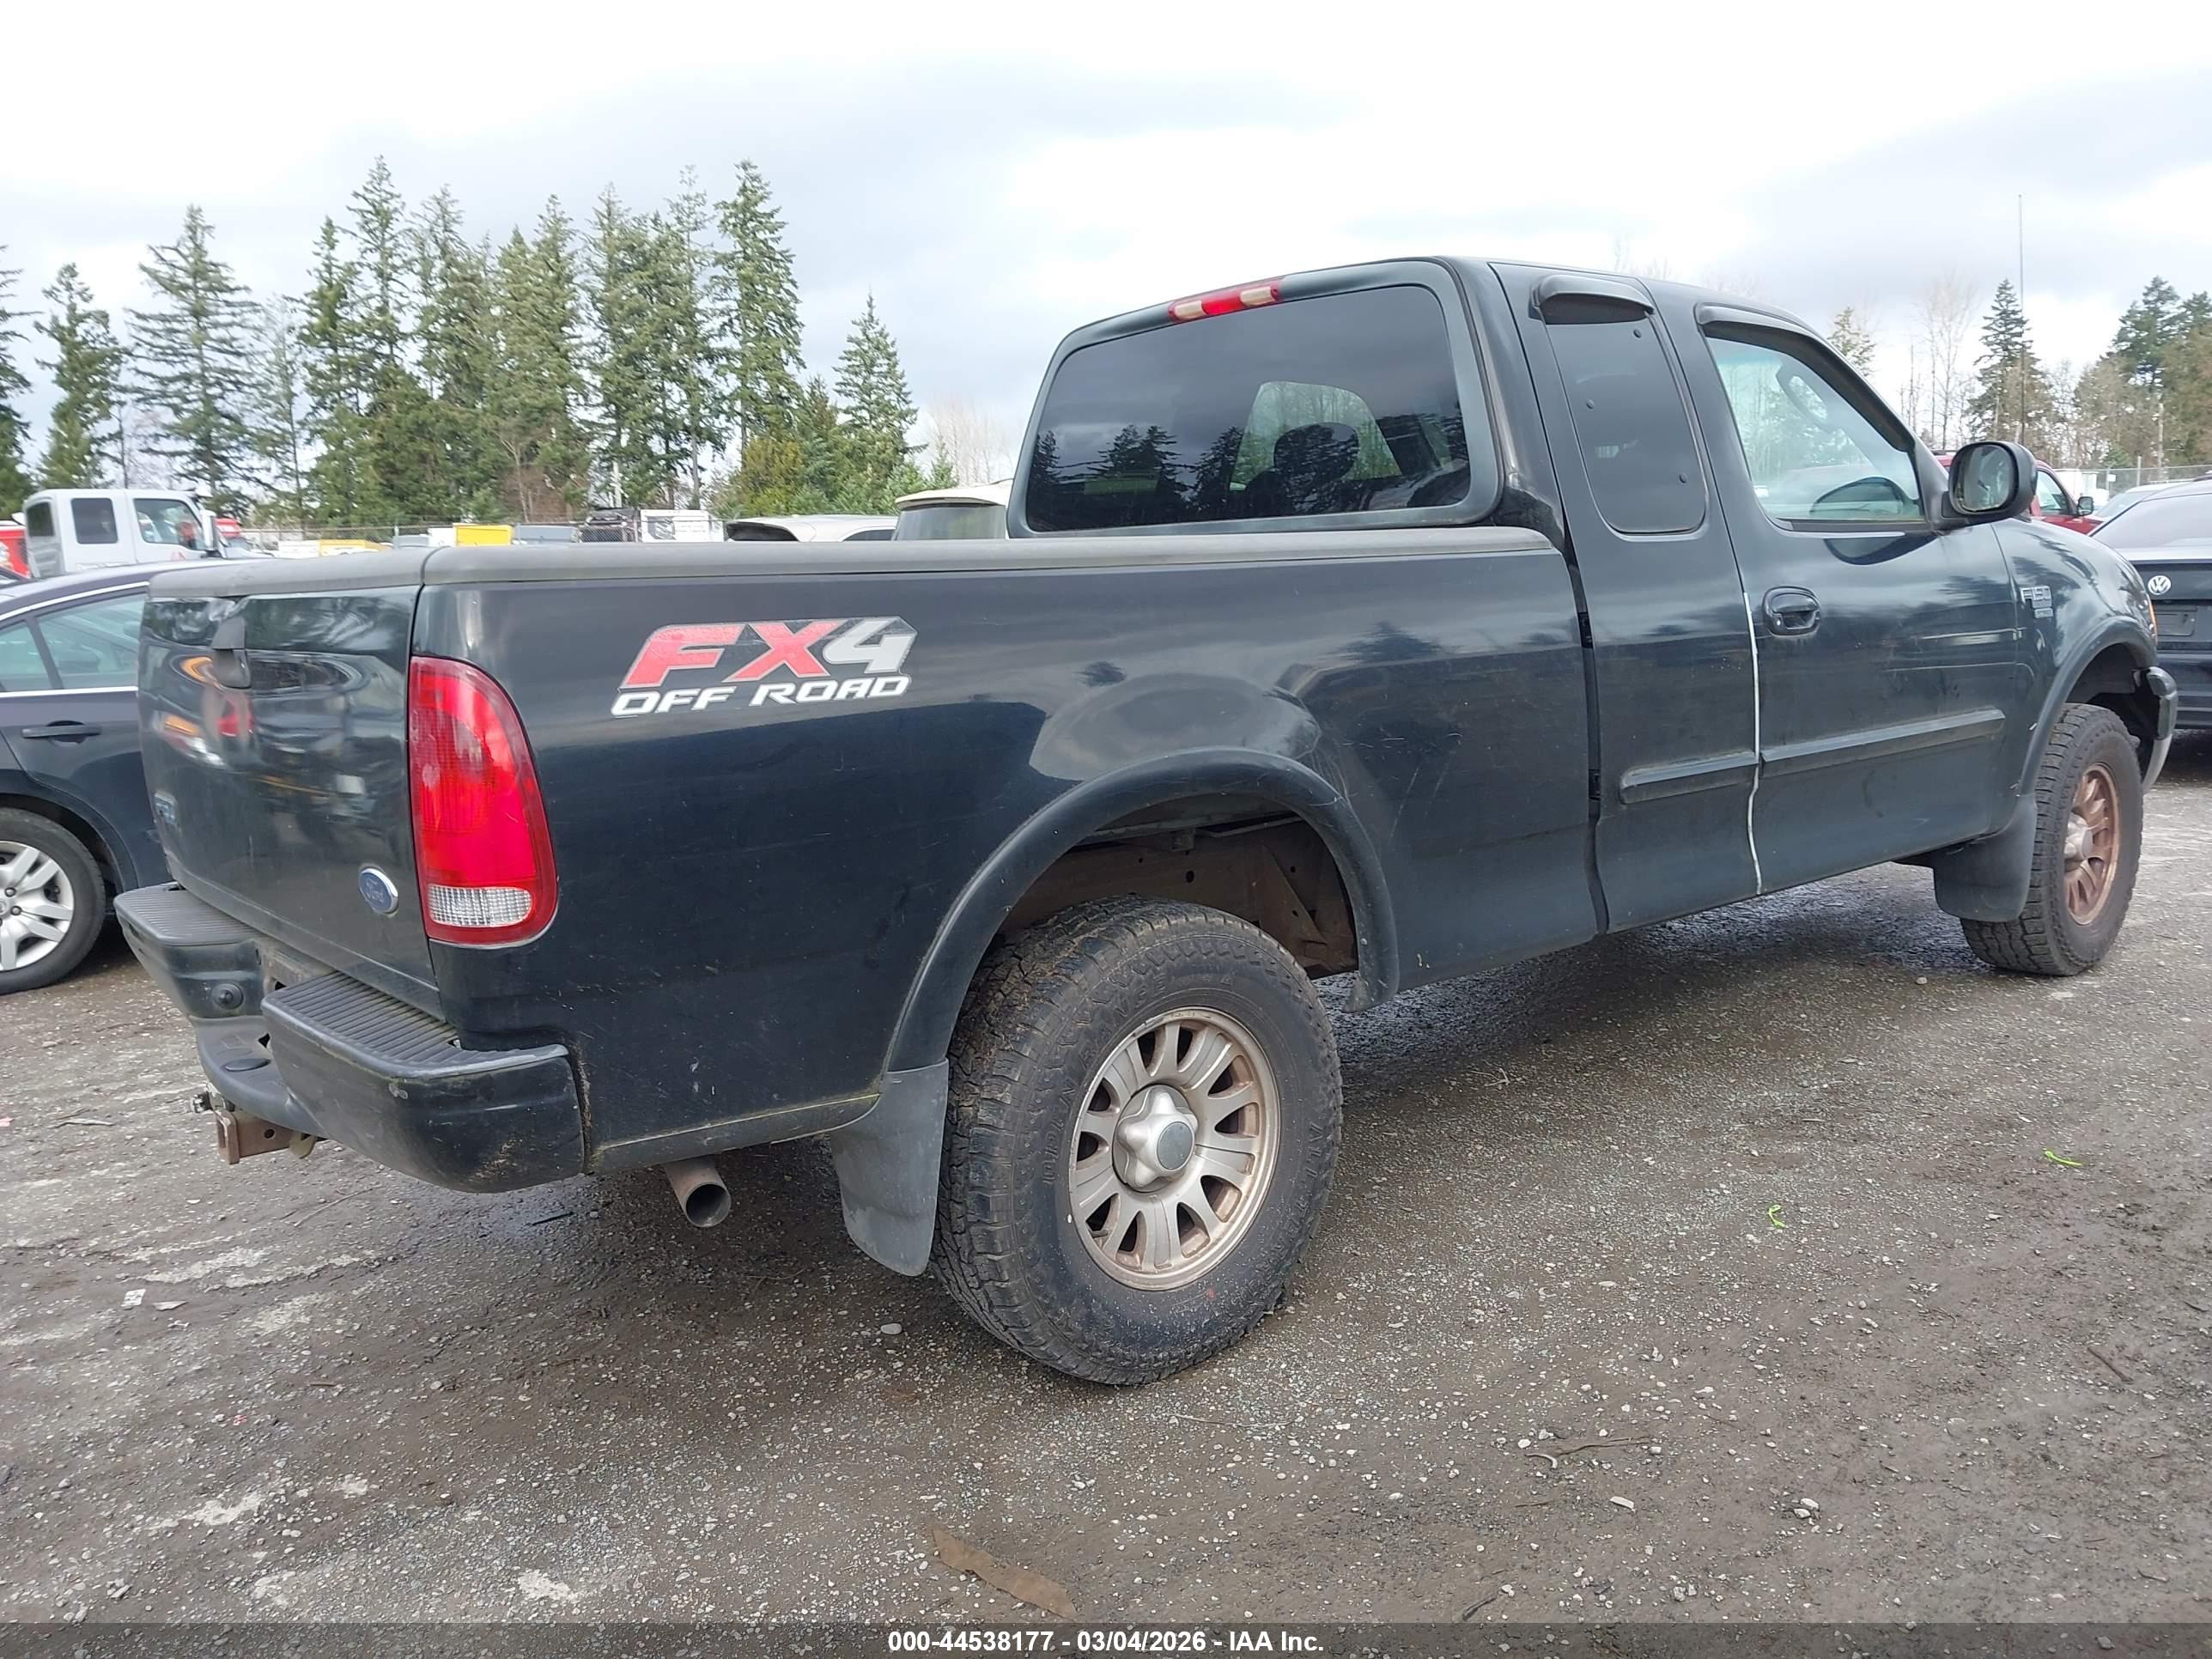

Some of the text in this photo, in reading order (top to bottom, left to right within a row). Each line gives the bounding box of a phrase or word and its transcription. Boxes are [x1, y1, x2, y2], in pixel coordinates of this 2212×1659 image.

[620, 617, 916, 689] FX4
[611, 675, 911, 715] OFF ROAD
